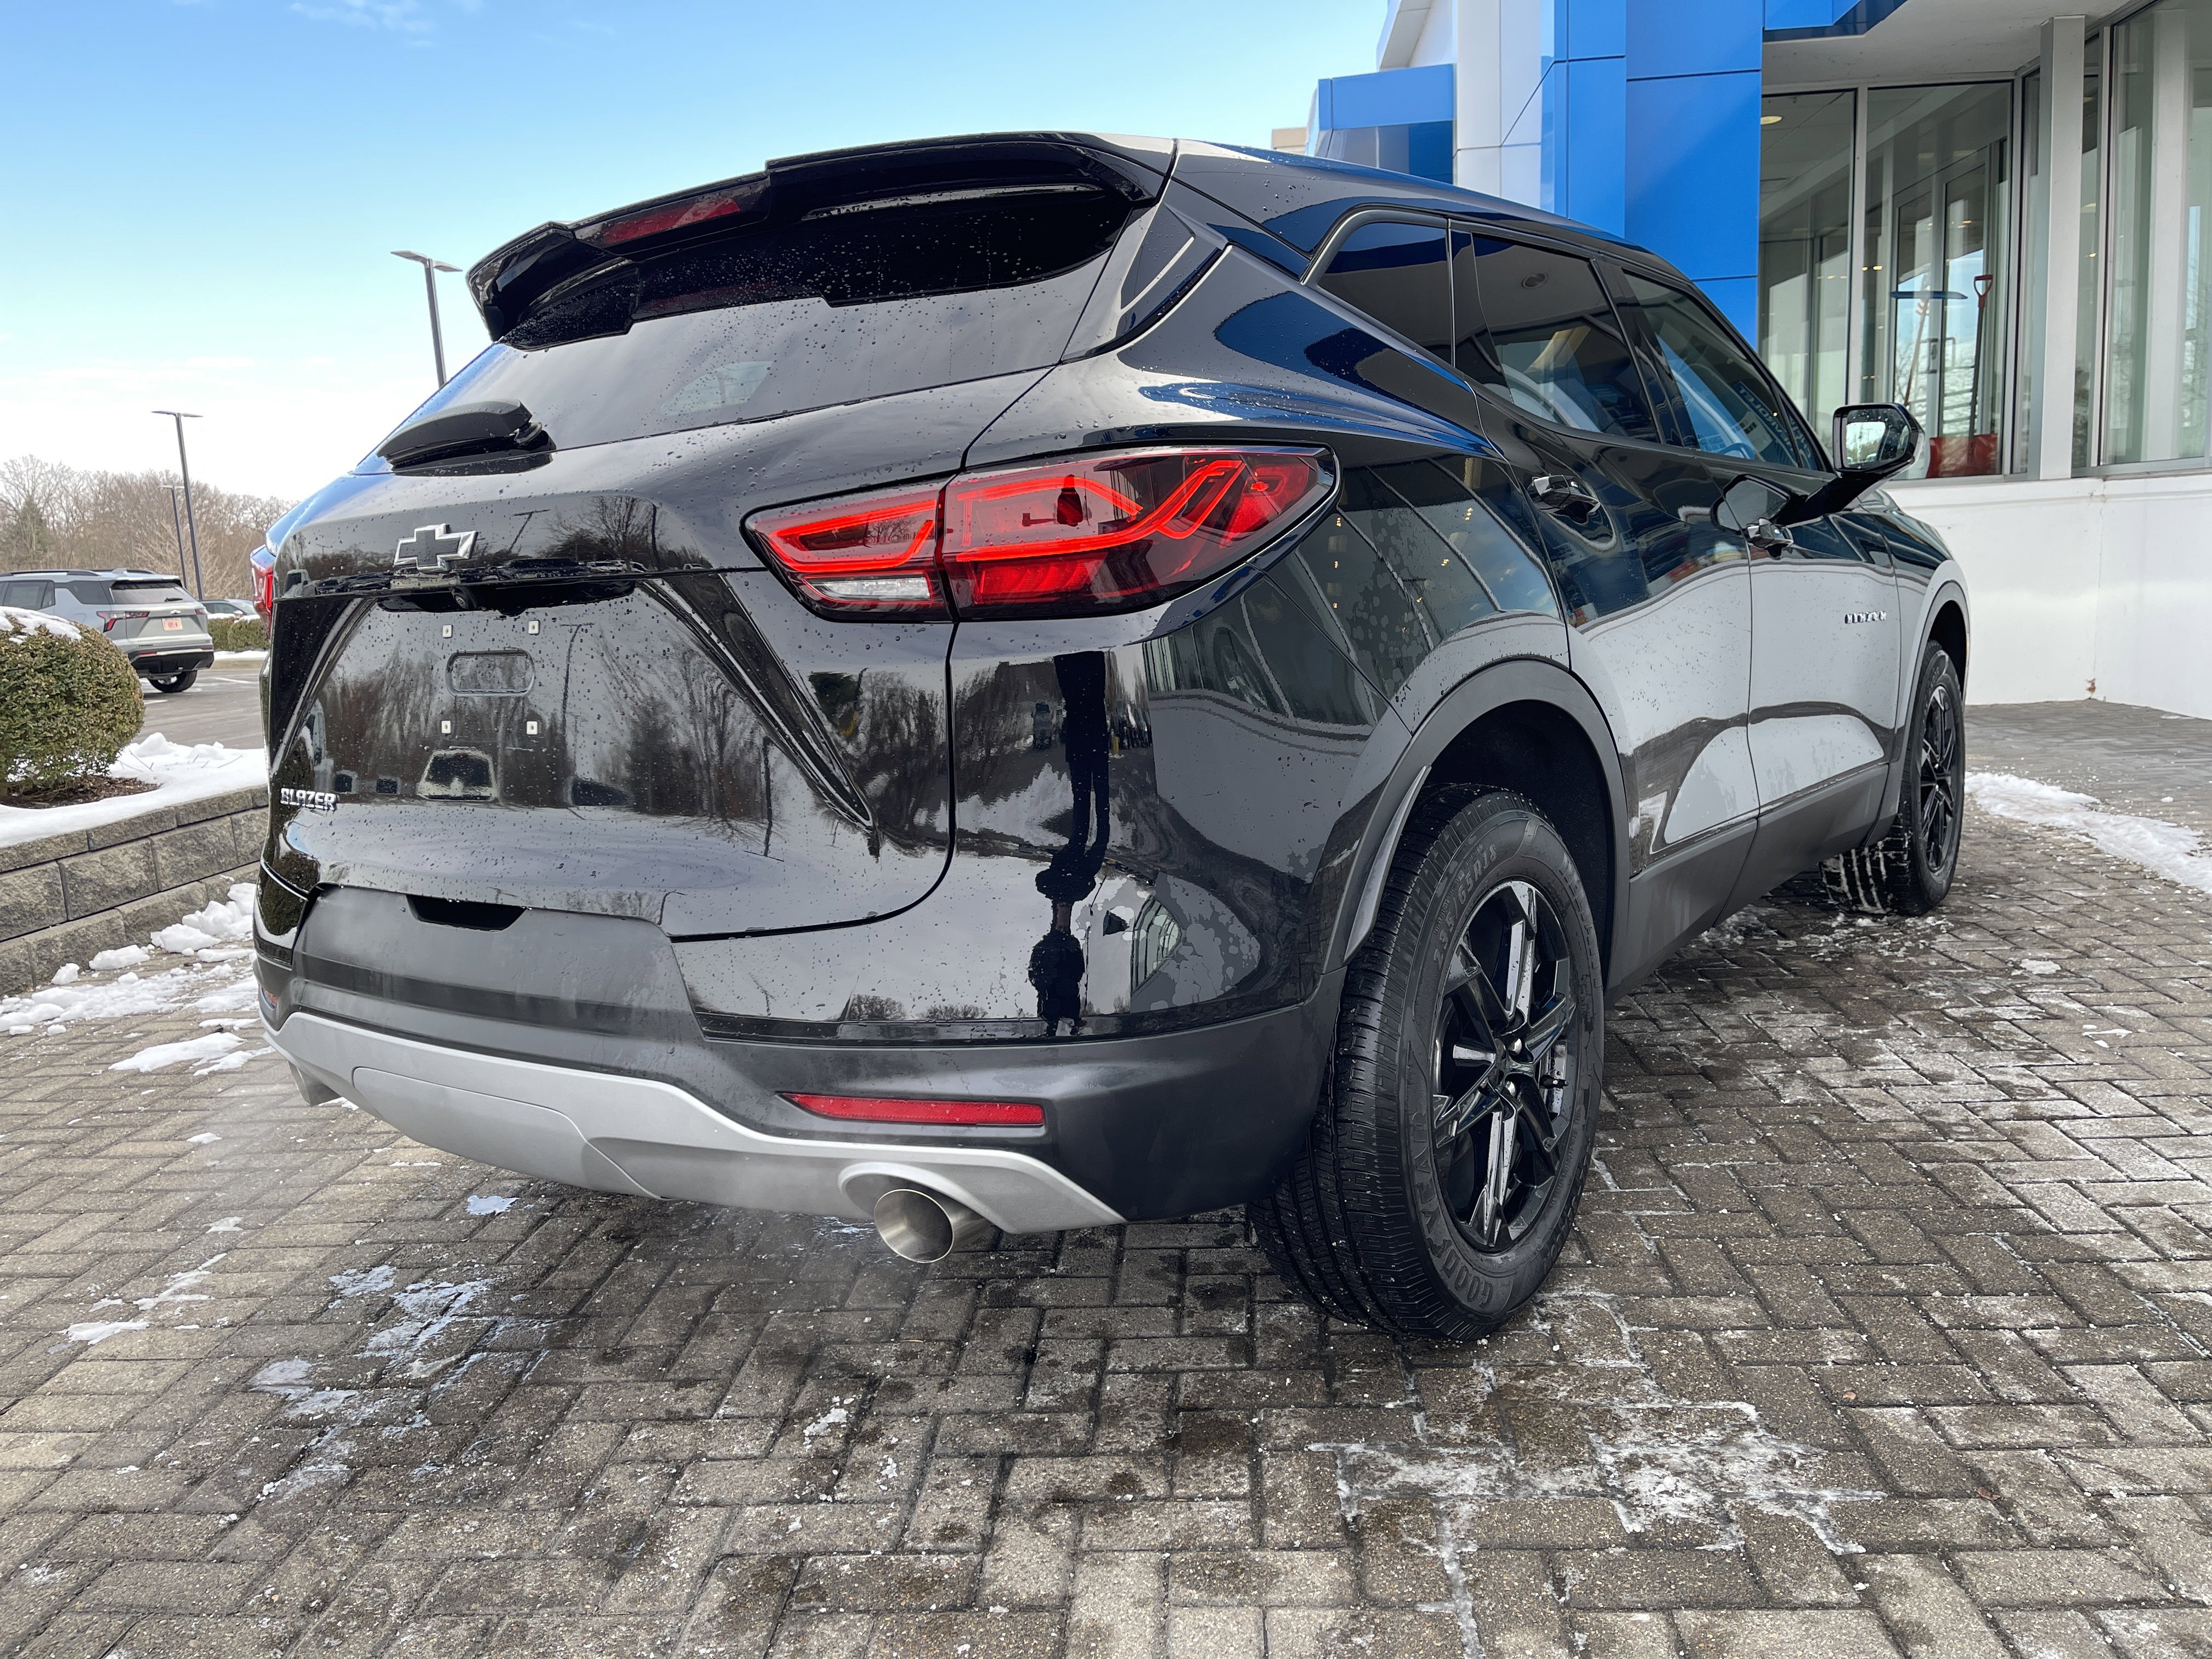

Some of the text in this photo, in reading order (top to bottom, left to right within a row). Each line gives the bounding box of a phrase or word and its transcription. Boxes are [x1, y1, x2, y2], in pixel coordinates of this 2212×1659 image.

[280, 788, 337, 811] BLAZER
[1433, 843, 1497, 970] 235/65R18
[1412, 1111, 1493, 1308] GOODYEAR
